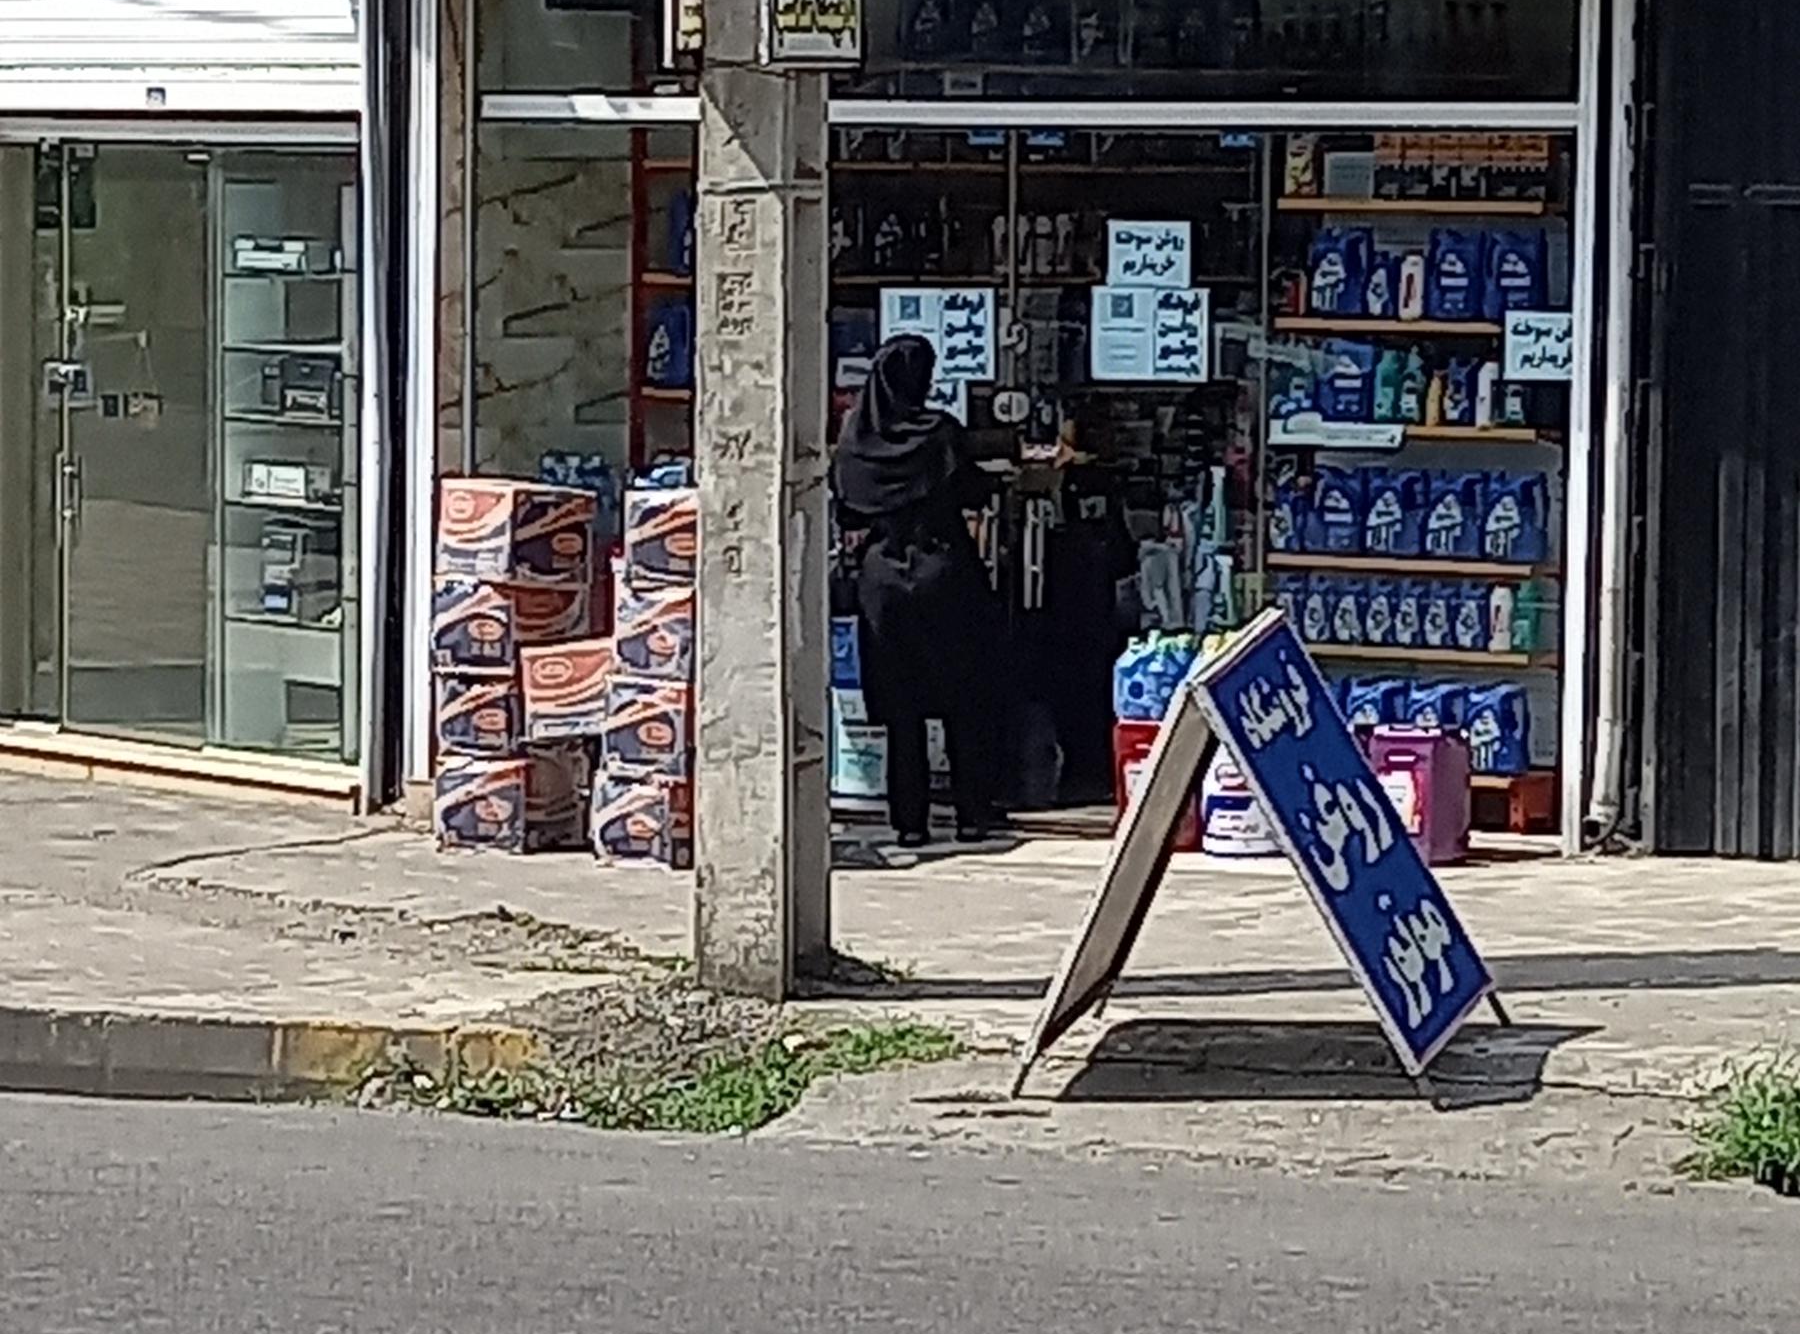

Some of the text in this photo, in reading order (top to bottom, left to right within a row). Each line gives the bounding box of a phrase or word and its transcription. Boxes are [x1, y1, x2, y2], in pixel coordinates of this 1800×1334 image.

[1237, 648, 1313, 750] فروشگاه
[1300, 765, 1396, 892] روغن
[1377, 893, 1454, 1030] موتور
